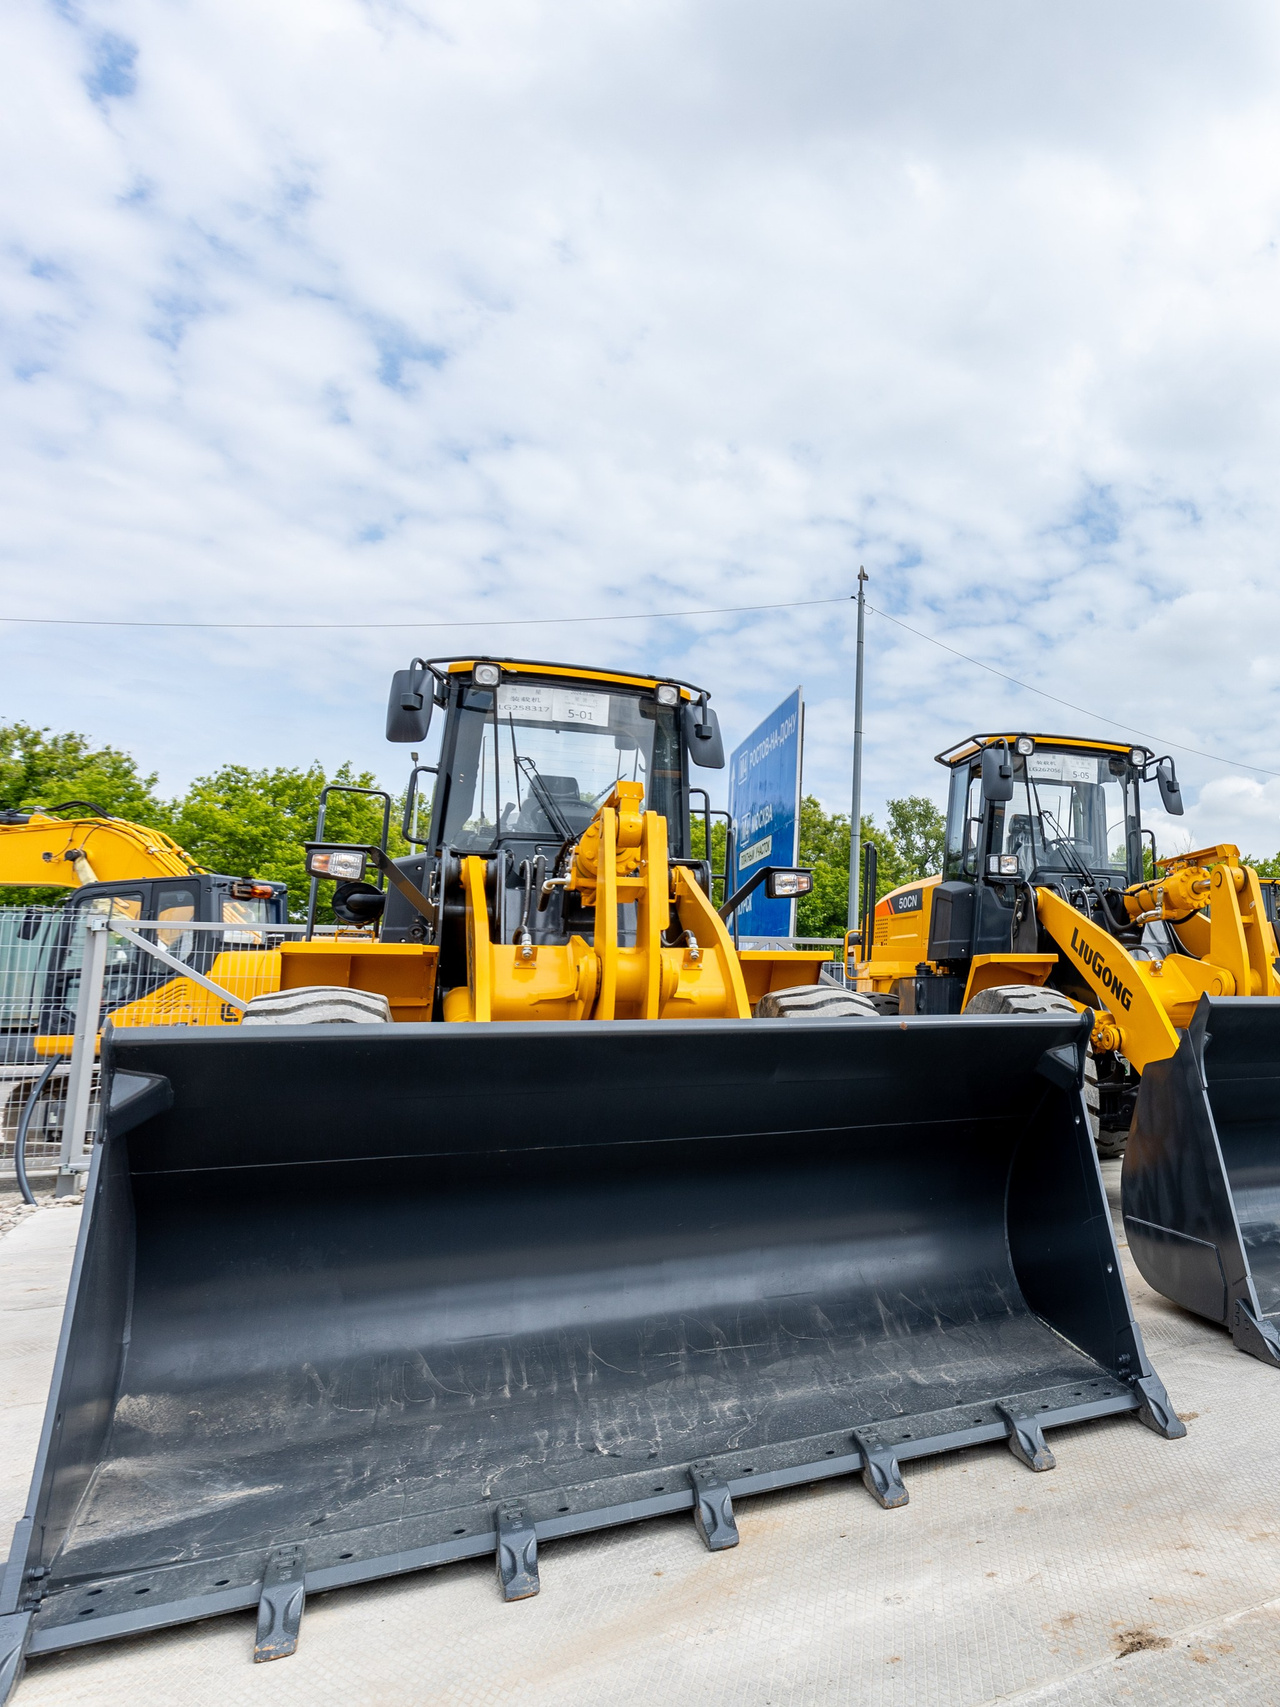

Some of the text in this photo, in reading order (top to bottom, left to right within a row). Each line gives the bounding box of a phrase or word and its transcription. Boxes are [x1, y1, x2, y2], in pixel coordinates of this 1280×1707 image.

[567, 709, 594, 721] 5-01
[749, 711, 797, 769] РОСТОВ-НА-ДОНУ
[898, 894, 918, 910] 50CN
